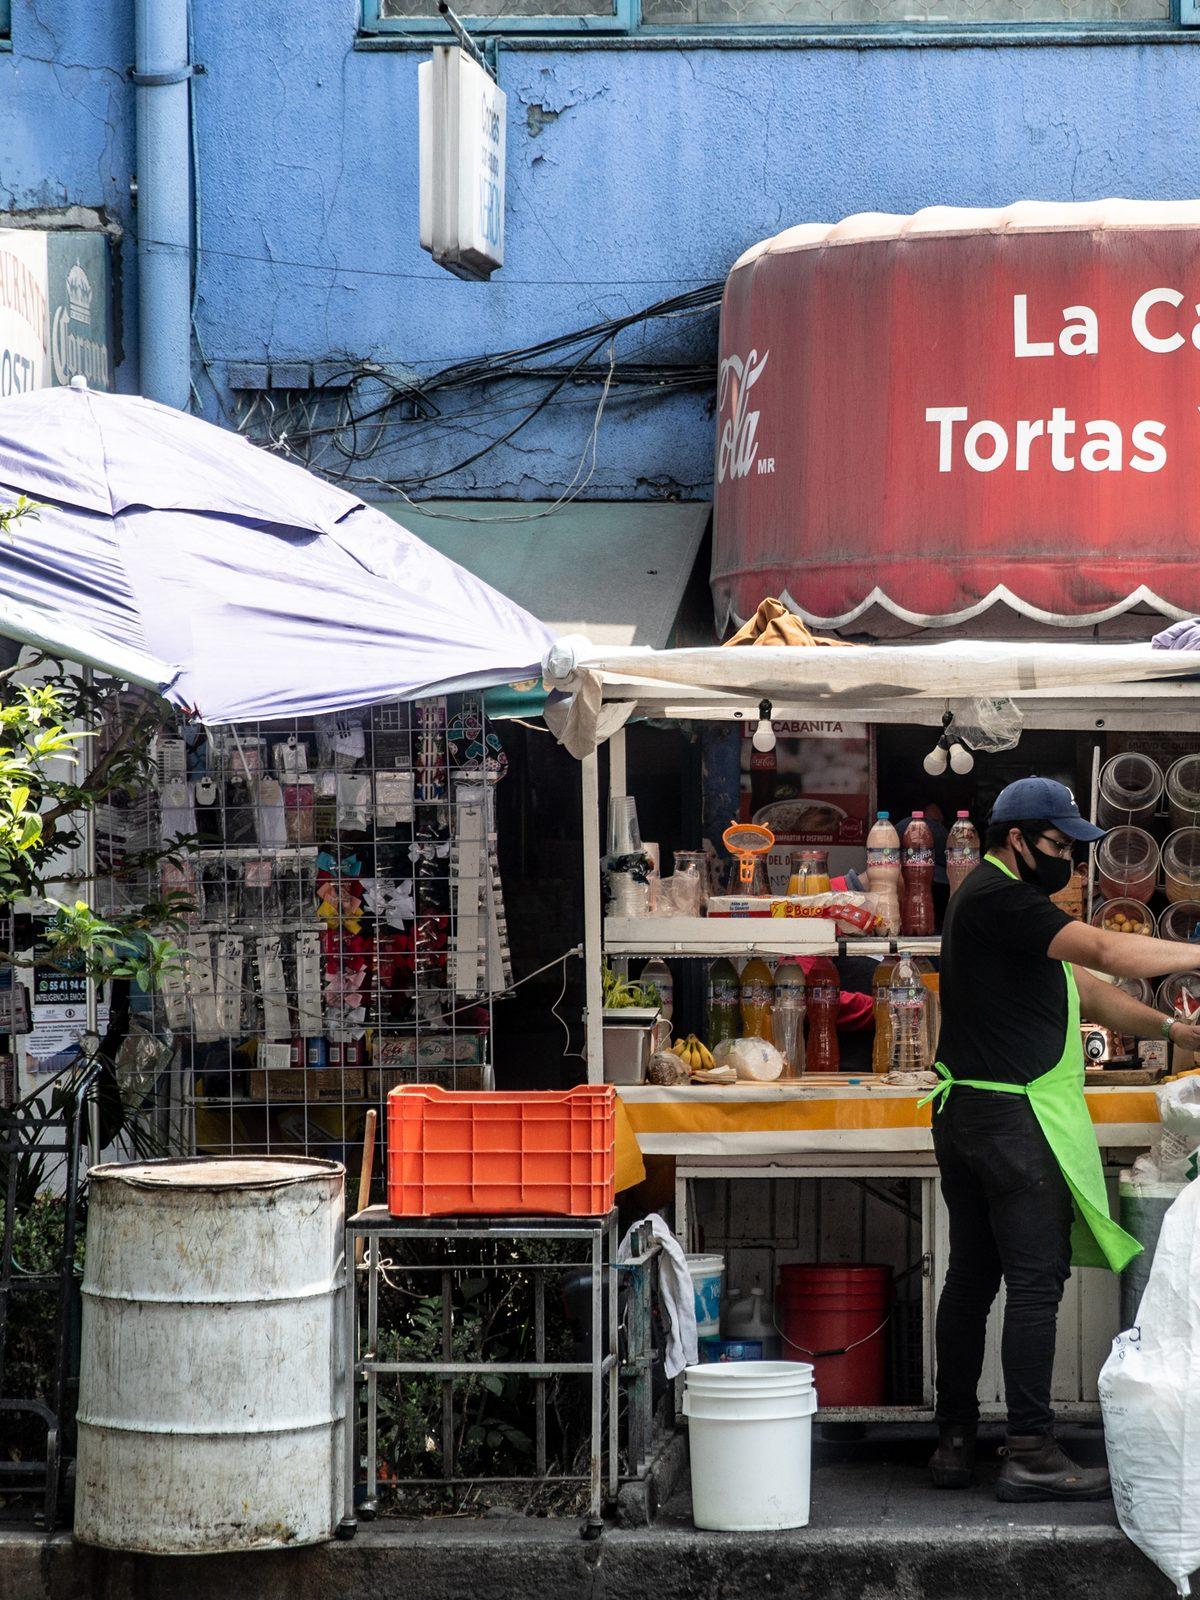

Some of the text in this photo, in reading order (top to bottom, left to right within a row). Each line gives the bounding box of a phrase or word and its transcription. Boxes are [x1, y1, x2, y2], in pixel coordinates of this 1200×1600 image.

[1014, 294, 1098, 358] La
[757, 457, 775, 475] MR
[926, 407, 1167, 472] Tortas
